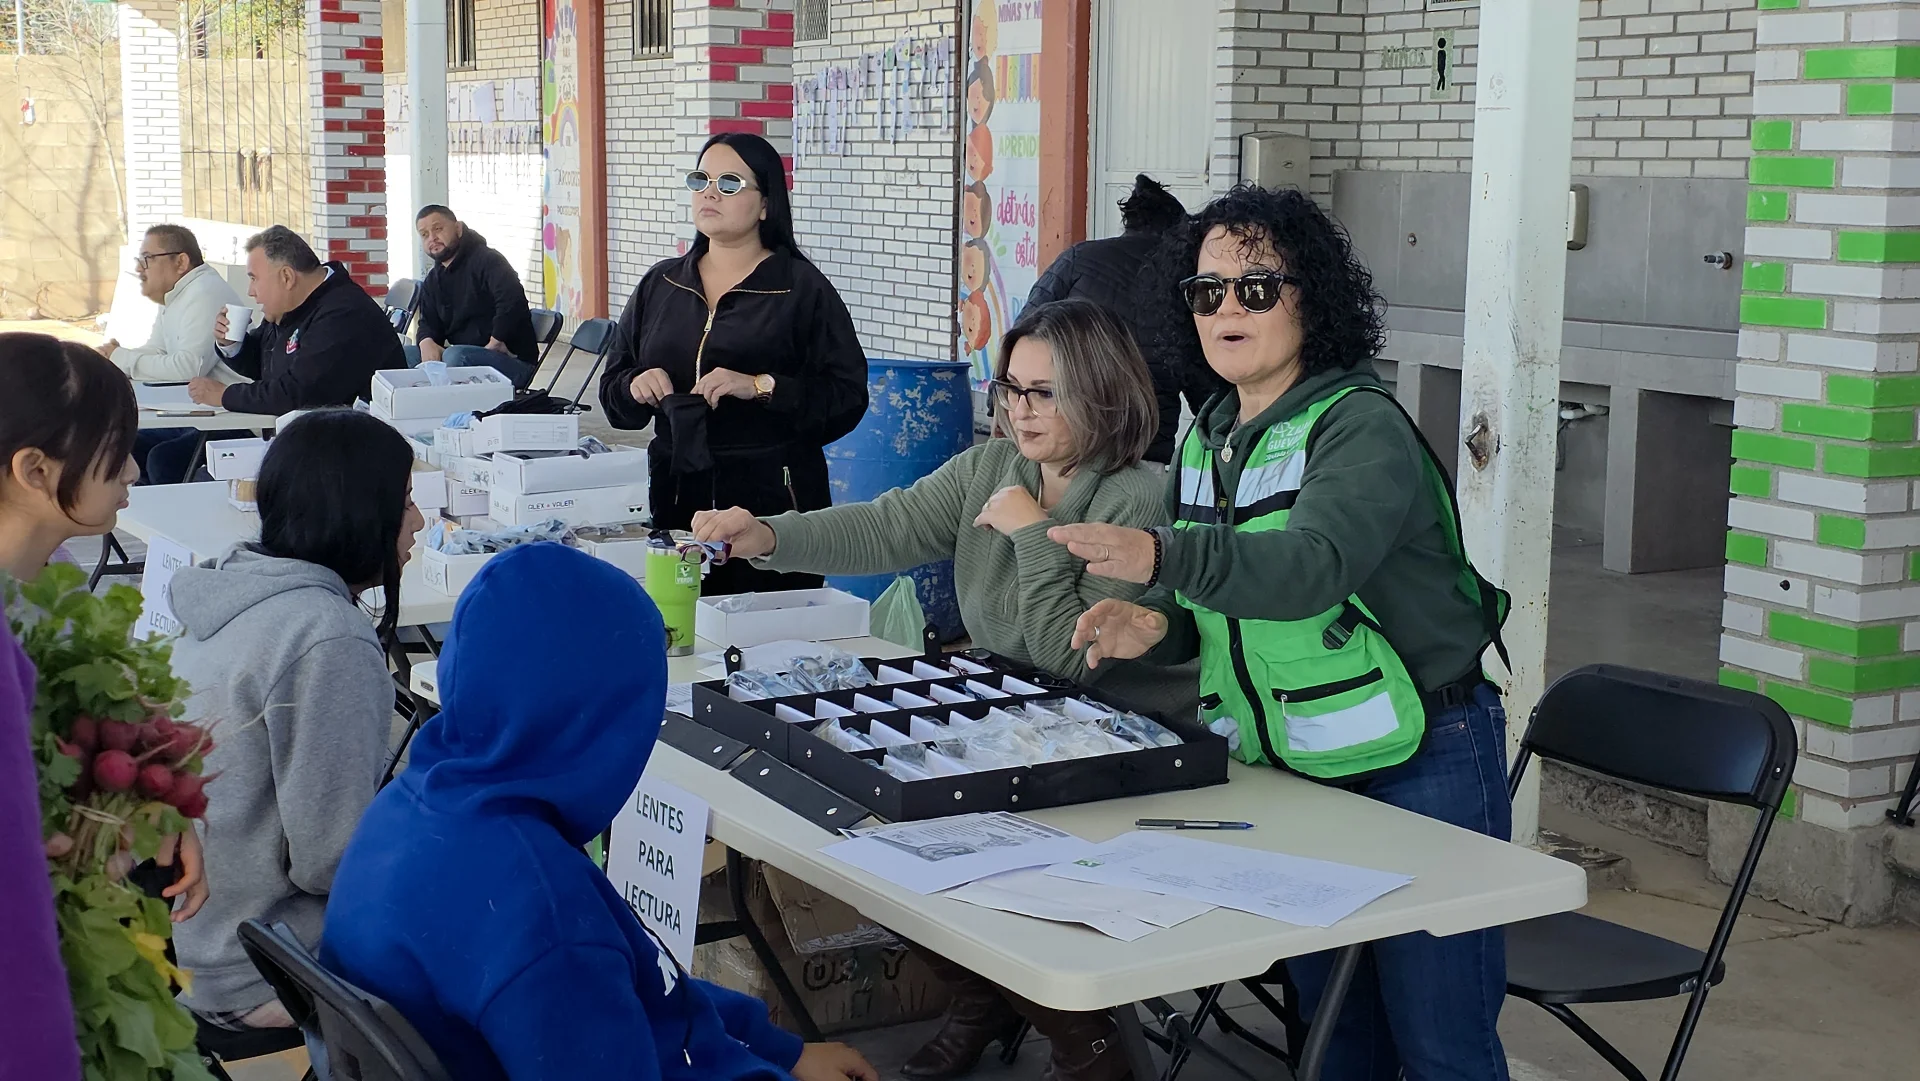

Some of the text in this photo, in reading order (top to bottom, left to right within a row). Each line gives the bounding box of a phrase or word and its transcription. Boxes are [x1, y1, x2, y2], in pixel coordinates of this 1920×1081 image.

[1025, 2, 1032, 20] Y
[997, 134, 1039, 158] APREND
[996, 187, 1036, 227] detrás
[149, 610, 176, 634] LECTUR
[635, 789, 684, 834] LENTES
[638, 838, 675, 880] PARA
[624, 879, 681, 935] LECTURA
